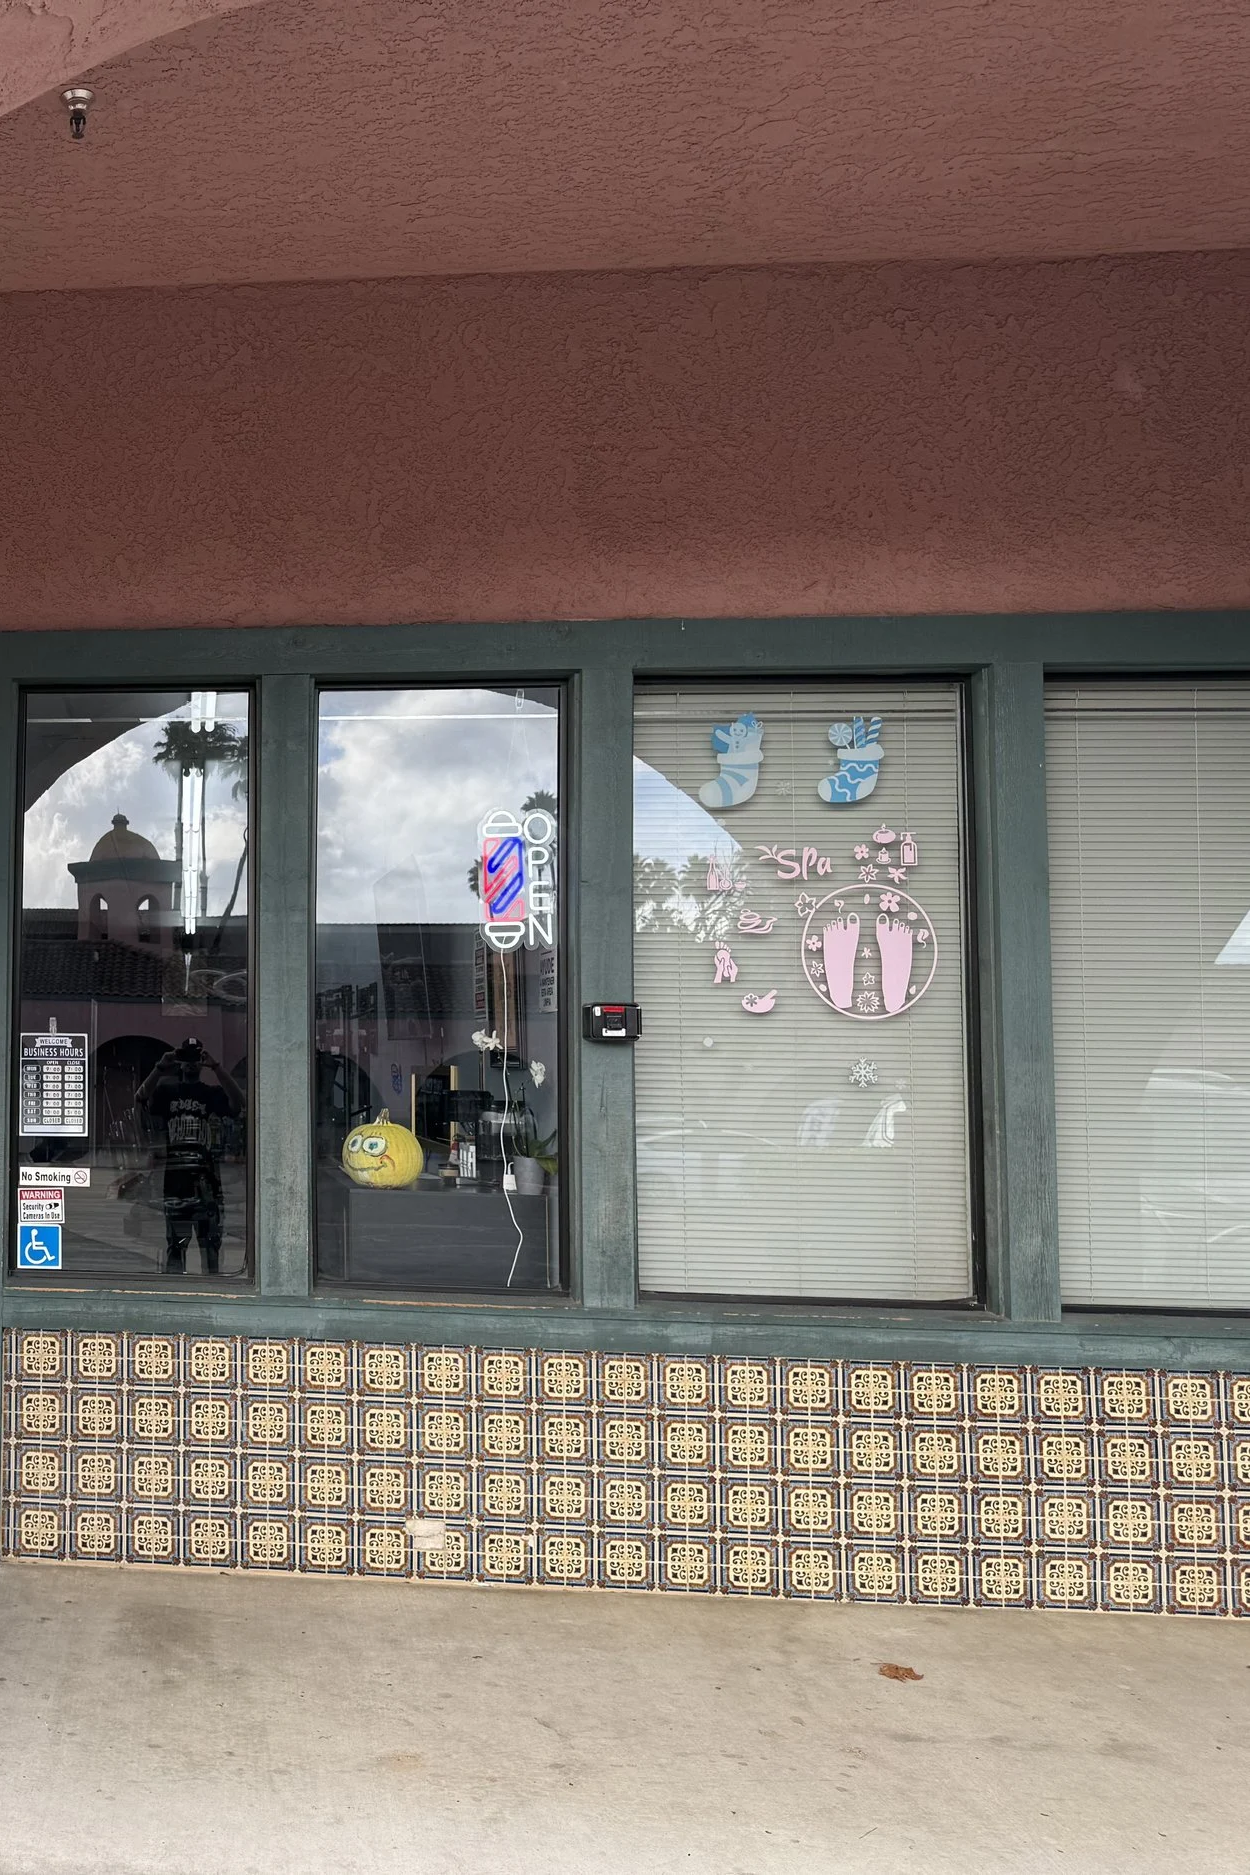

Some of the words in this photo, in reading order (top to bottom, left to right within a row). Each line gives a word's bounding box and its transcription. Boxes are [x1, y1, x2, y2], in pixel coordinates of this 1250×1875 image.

[523, 812, 553, 946] OPEN
[23, 1047, 58, 1057] BUSINESS
[59, 1048, 84, 1057] HOURS
[21, 1171, 33, 1181] No
[35, 1171, 71, 1184] Smoking
[21, 1190, 61, 1200] WARNING
[22, 1202, 44, 1211] Security
[22, 1211, 44, 1220] Cameras
